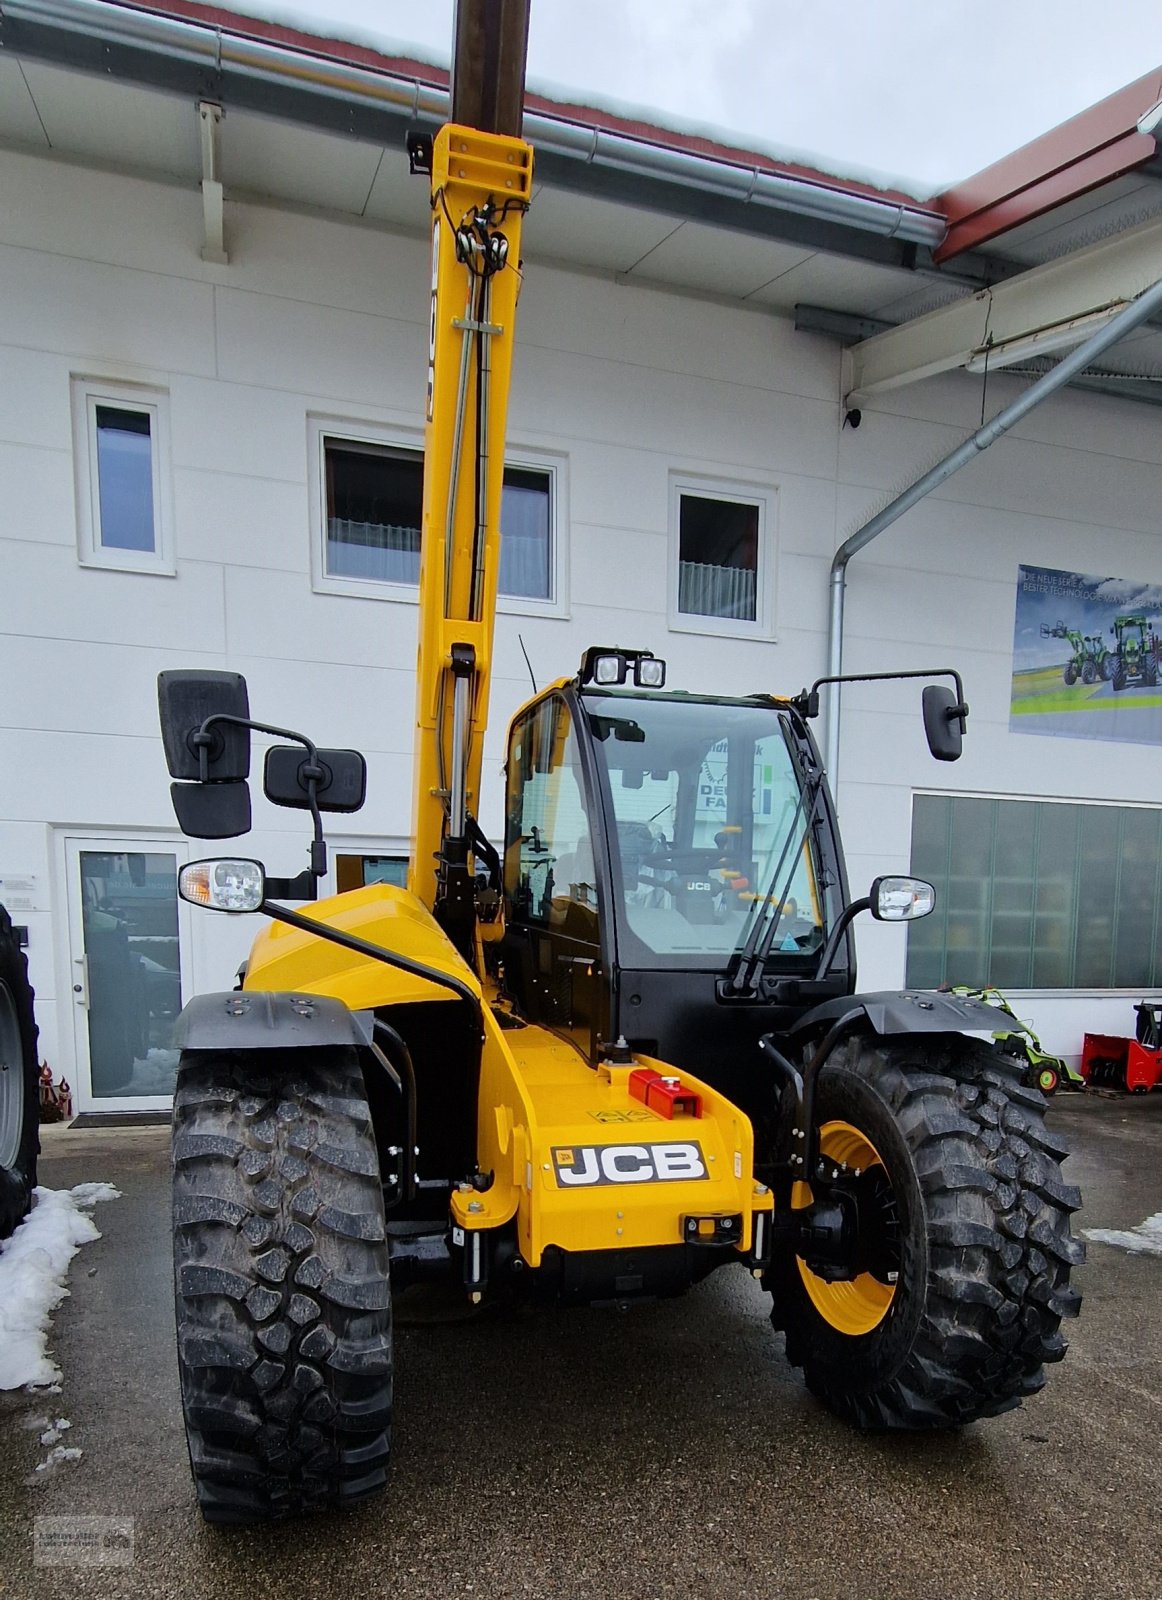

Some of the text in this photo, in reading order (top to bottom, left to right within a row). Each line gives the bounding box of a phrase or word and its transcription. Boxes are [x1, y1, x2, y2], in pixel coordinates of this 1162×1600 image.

[1037, 574, 1058, 585] NEUE
[1058, 576, 1078, 588] SERIE
[1023, 582, 1049, 593] BESTER
[687, 881, 711, 891] JCB
[558, 1144, 705, 1185] JCB
